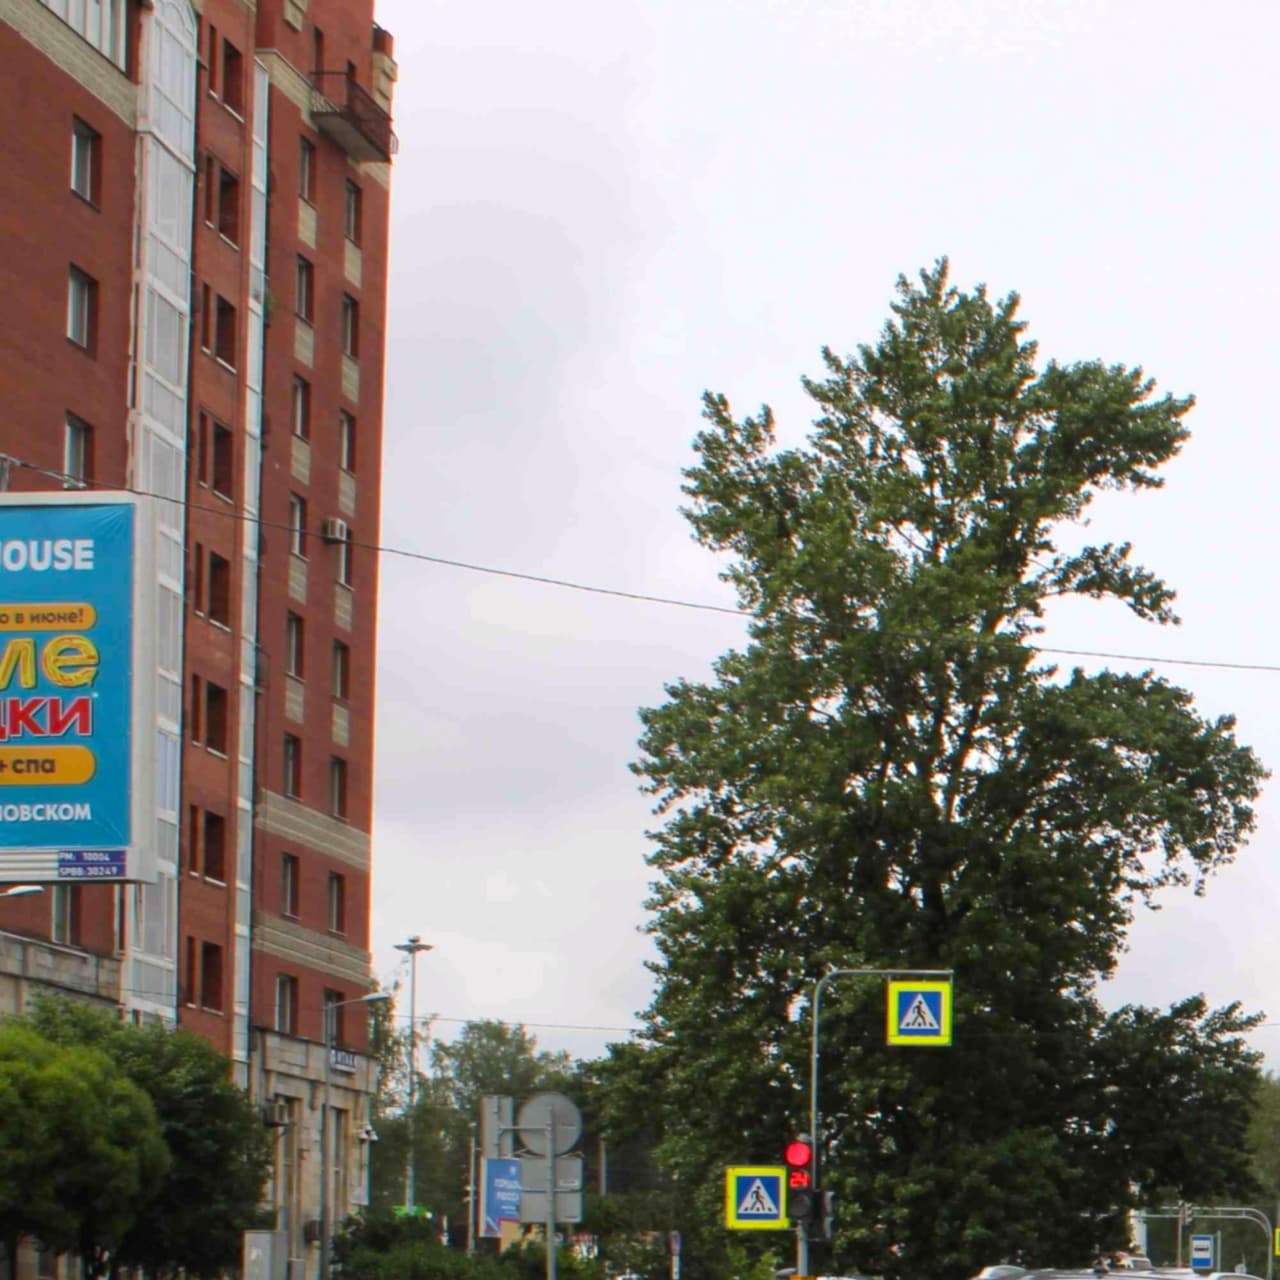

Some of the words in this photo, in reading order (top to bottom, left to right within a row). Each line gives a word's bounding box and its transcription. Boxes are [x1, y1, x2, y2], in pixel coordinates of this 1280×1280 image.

[0, 539, 95, 571] OUSE
[12, 757, 56, 774] спа
[0, 803, 91, 822] ОВСКОМ
